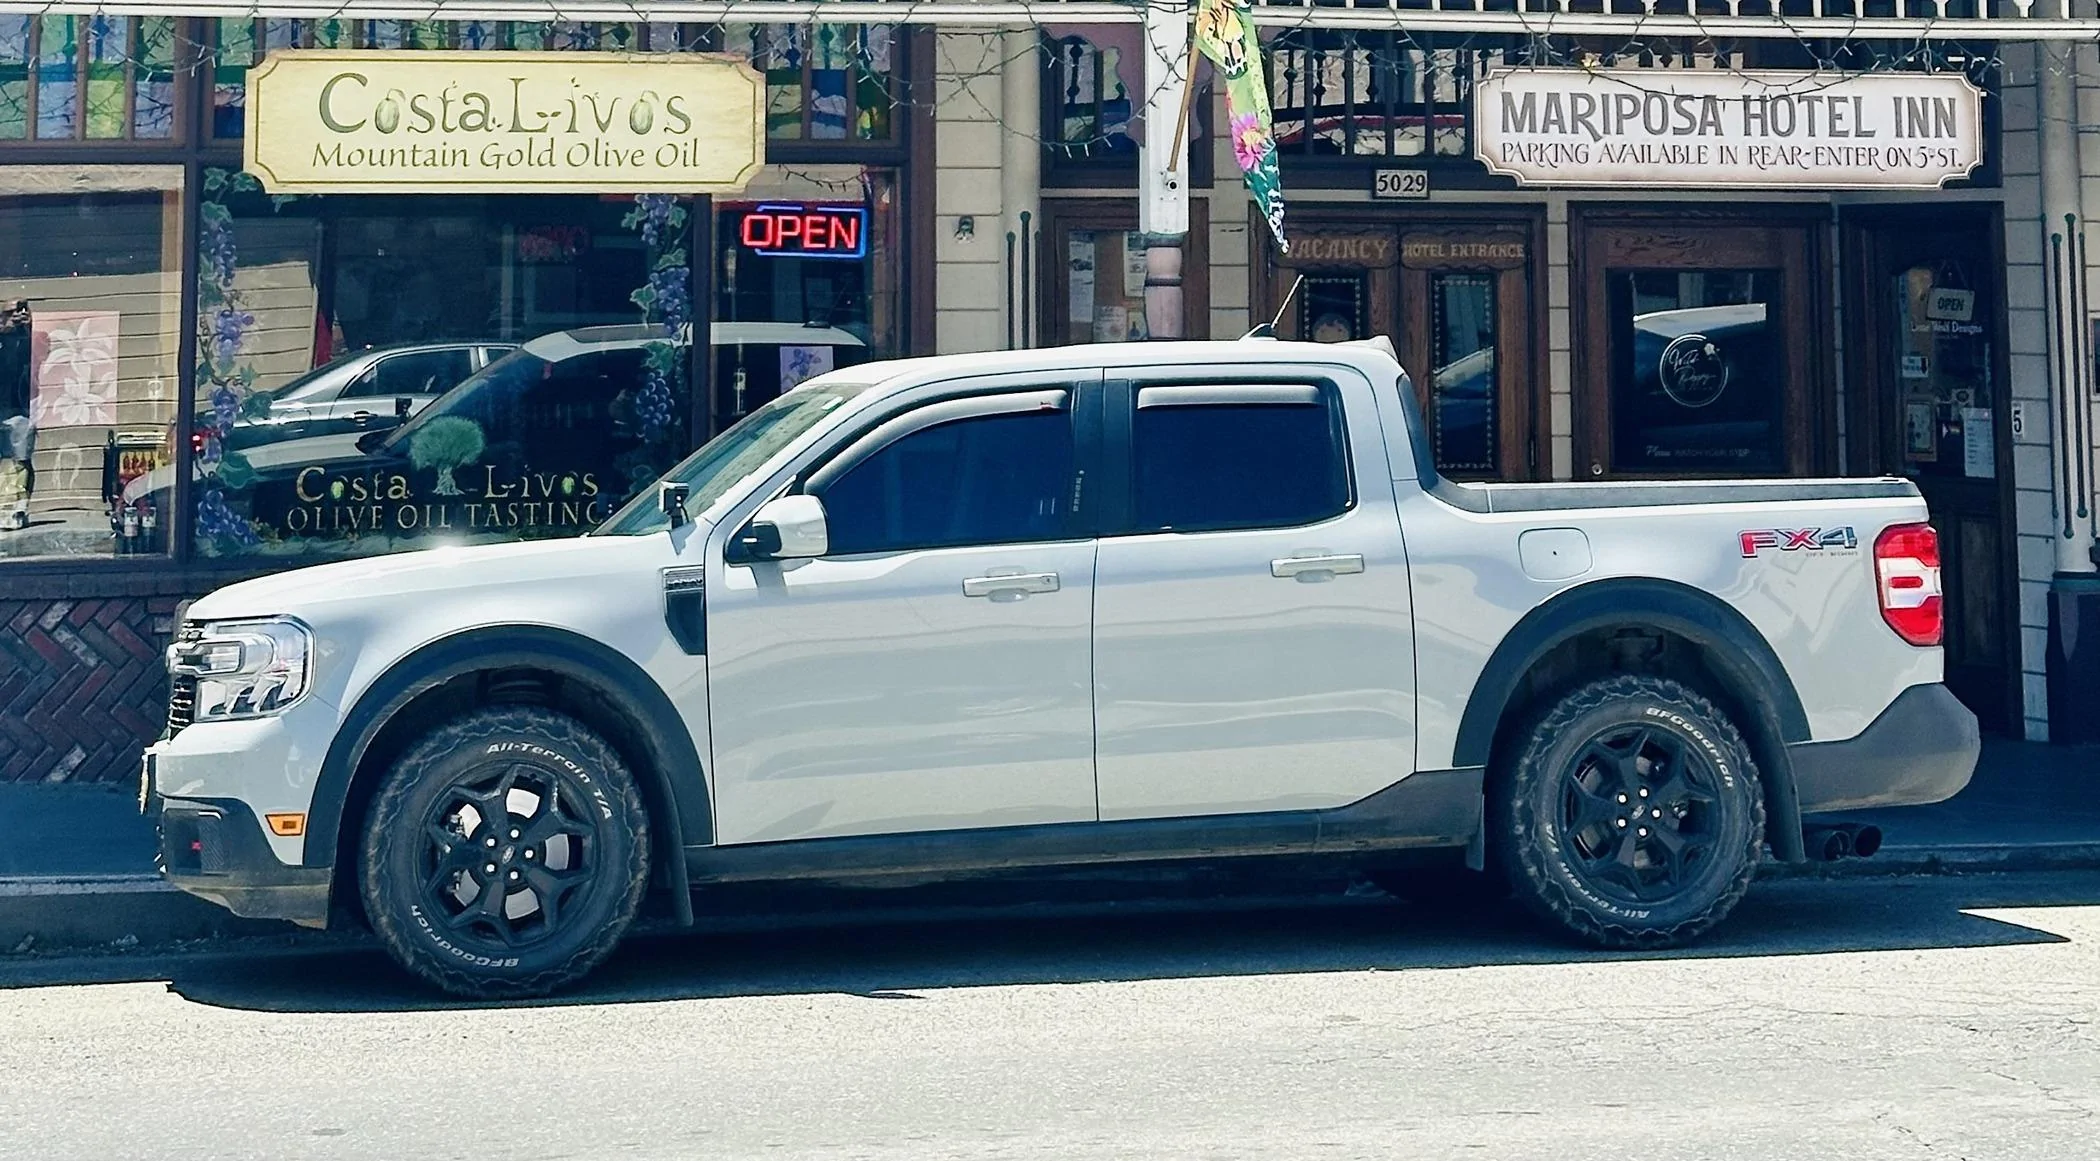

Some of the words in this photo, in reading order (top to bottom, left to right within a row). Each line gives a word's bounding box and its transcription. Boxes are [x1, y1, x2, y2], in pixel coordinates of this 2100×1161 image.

[1501, 91, 1724, 142] MARIPOSA
[1742, 94, 1877, 138] HOTEL
[1893, 96, 1957, 138] INN
[312, 142, 470, 168] Mountain
[480, 137, 556, 169] Gold
[566, 137, 645, 168] Olive
[655, 138, 700, 168] Oil
[1502, 142, 1590, 168] PARKING
[1598, 142, 1708, 165] AVAILABLE
[1720, 144, 1738, 165] IN
[1886, 146, 1911, 167] ON
[1377, 174, 1426, 193] 5029
[741, 214, 858, 249] OPEN
[1403, 243, 1446, 257] HOTEL
[1451, 243, 1525, 258] ENTRANCE
[1937, 297, 1964, 312] OPEN
[2012, 409, 2022, 433] 5
[296, 466, 409, 501] Costa
[287, 505, 384, 531] OLIVE
[397, 504, 452, 531] OIL
[1738, 527, 1858, 559] FX4
[1646, 706, 1735, 788] BFGoodrich
[486, 742, 591, 784] All-Terrain
[593, 788, 613, 820] T/A
[410, 904, 519, 968] BFGoodrich
